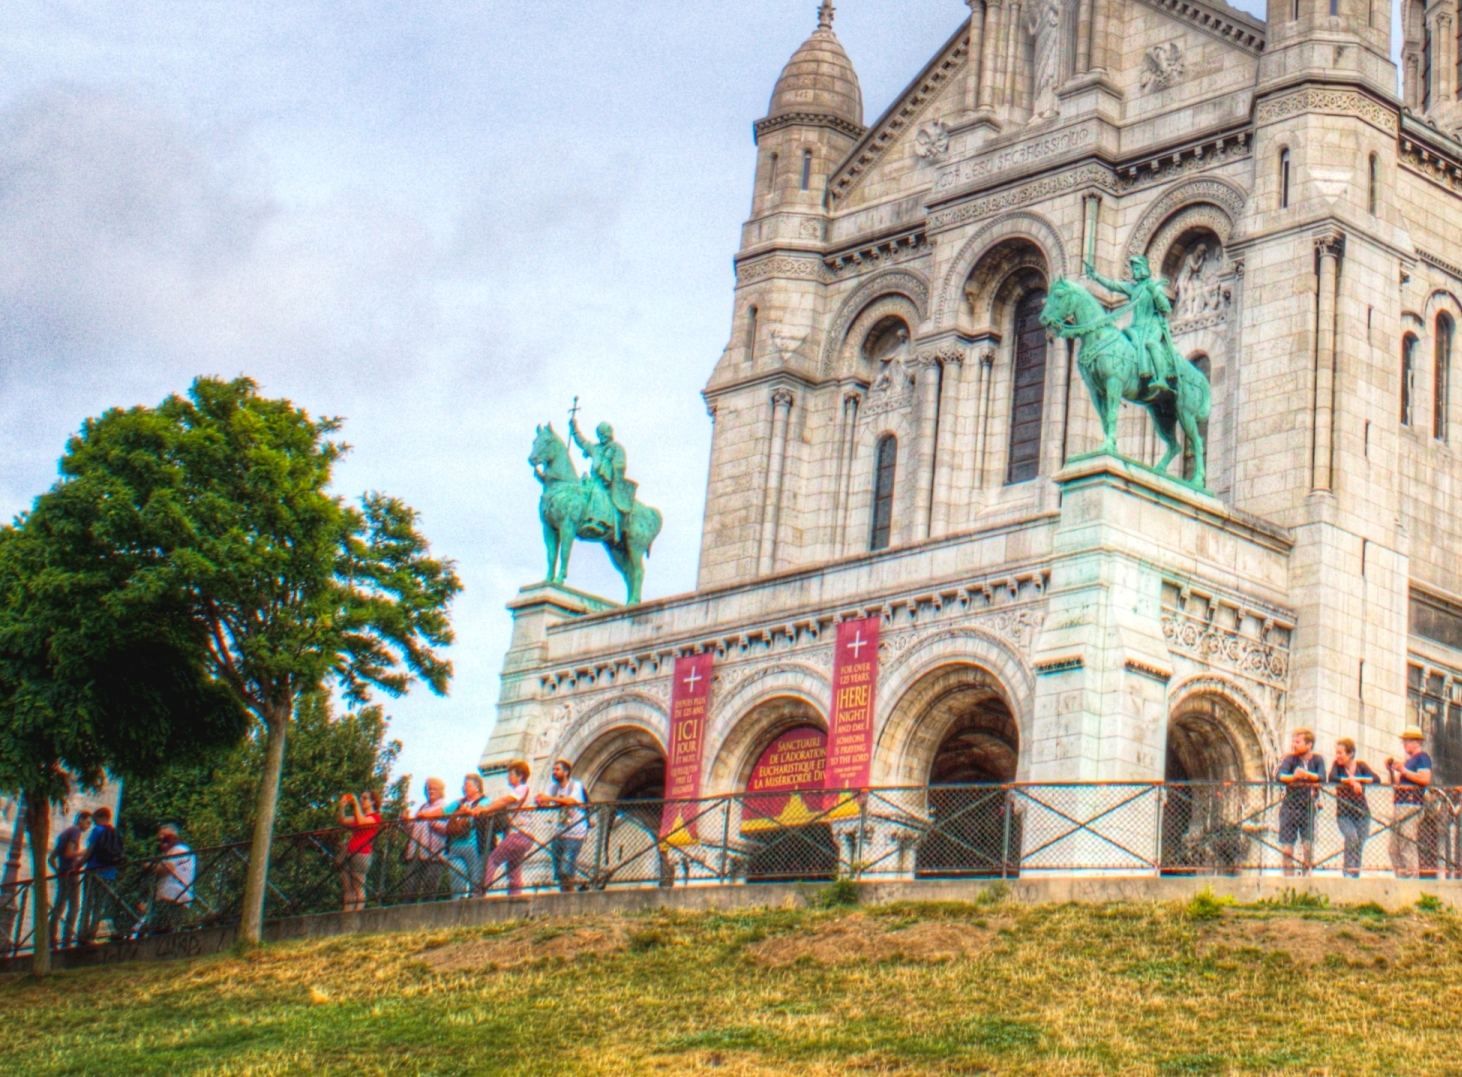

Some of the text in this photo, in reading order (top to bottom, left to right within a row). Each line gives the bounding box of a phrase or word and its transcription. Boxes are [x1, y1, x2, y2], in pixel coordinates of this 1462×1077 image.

[841, 662, 871, 674] FOR OVER
[840, 675, 850, 684] 125
[693, 697, 706, 706] PLUS
[840, 685, 868, 709] HERE
[683, 707, 692, 717] 125
[838, 708, 866, 723] NIGHT
[677, 719, 698, 741] ICI
[837, 724, 851, 734] AND
[777, 737, 820, 752] SANCTUAIRE
[836, 733, 865, 745] SOMEONE
[676, 740, 697, 755] JOUR
[840, 743, 866, 755] PRAYING
[769, 753, 779, 764] DE
[830, 752, 869, 766] TO THE LORD
[759, 758, 826, 777] EUCHARISTIQUE ET
[754, 779, 764, 789] LA
[764, 772, 812, 788] MISÉRICORDE
